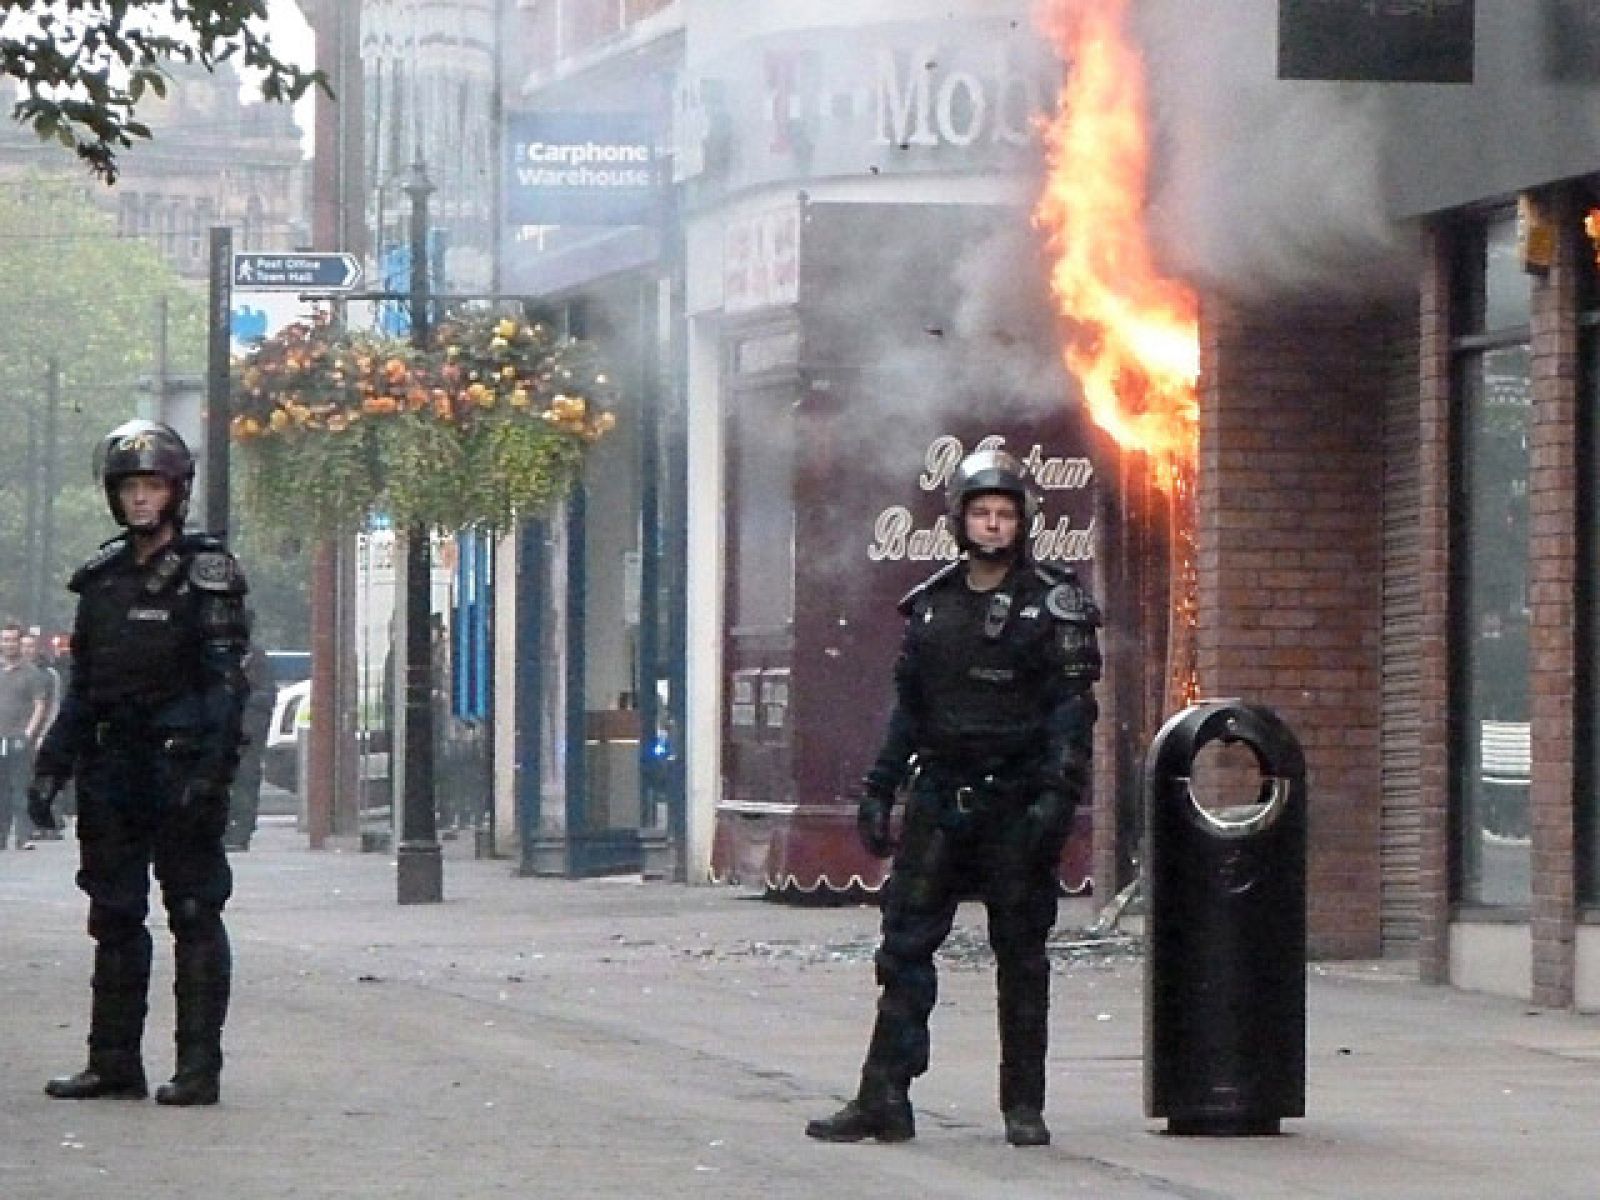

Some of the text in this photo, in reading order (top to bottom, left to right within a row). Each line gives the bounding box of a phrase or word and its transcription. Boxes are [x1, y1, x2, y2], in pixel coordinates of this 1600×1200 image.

[529, 141, 649, 166] Carphone
[518, 167, 649, 187] Warehouse
[257, 257, 321, 270] Post Office
[257, 270, 314, 282] Town Hall
